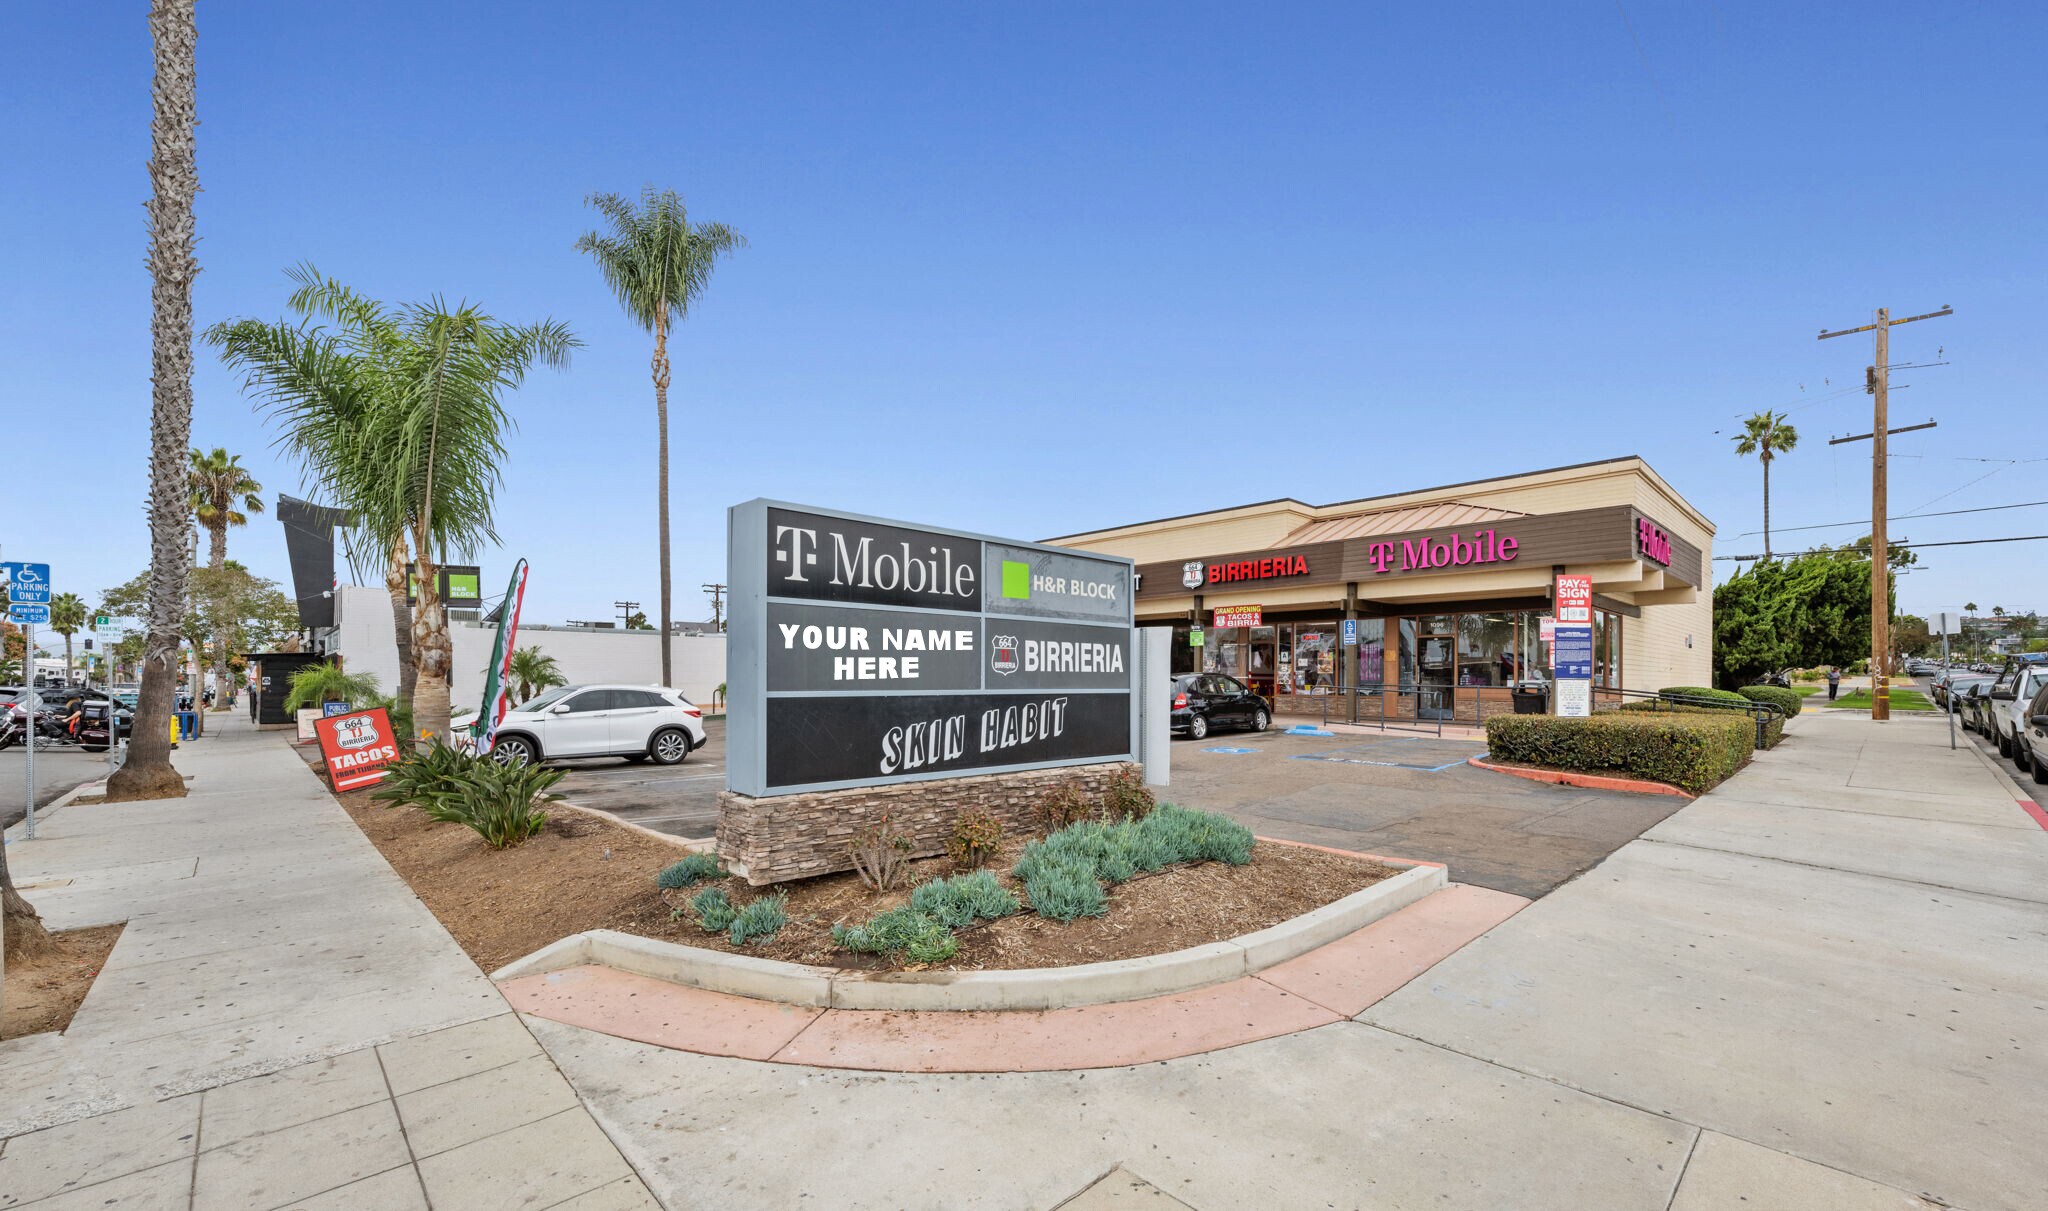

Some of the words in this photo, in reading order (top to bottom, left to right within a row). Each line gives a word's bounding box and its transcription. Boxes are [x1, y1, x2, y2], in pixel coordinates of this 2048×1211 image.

[1401, 530, 1519, 571] Mobile
[829, 532, 975, 598] Mobile
[1208, 555, 1309, 583] BIRRIERIA
[11, 582, 49, 591] PARKING
[1033, 575, 1066, 594] H&R
[1071, 580, 1116, 600] BLOCK
[1559, 579, 1580, 588] PAY
[1559, 588, 1590, 598] SIGN
[19, 592, 41, 600] ONLY
[778, 623, 869, 651] YOUR
[882, 628, 974, 651] NAME
[998, 638, 1012, 648] 664
[1024, 639, 1124, 673] BIRRIERIA
[833, 656, 919, 681] HERE
[344, 719, 363, 729] 664
[349, 727, 363, 738] TJ
[341, 734, 376, 747] BIRRIERIA
[880, 715, 966, 775] SKIN
[980, 697, 1068, 752] HABIT
[331, 745, 396, 770] TACOS
[335, 769, 357, 779] FROM
